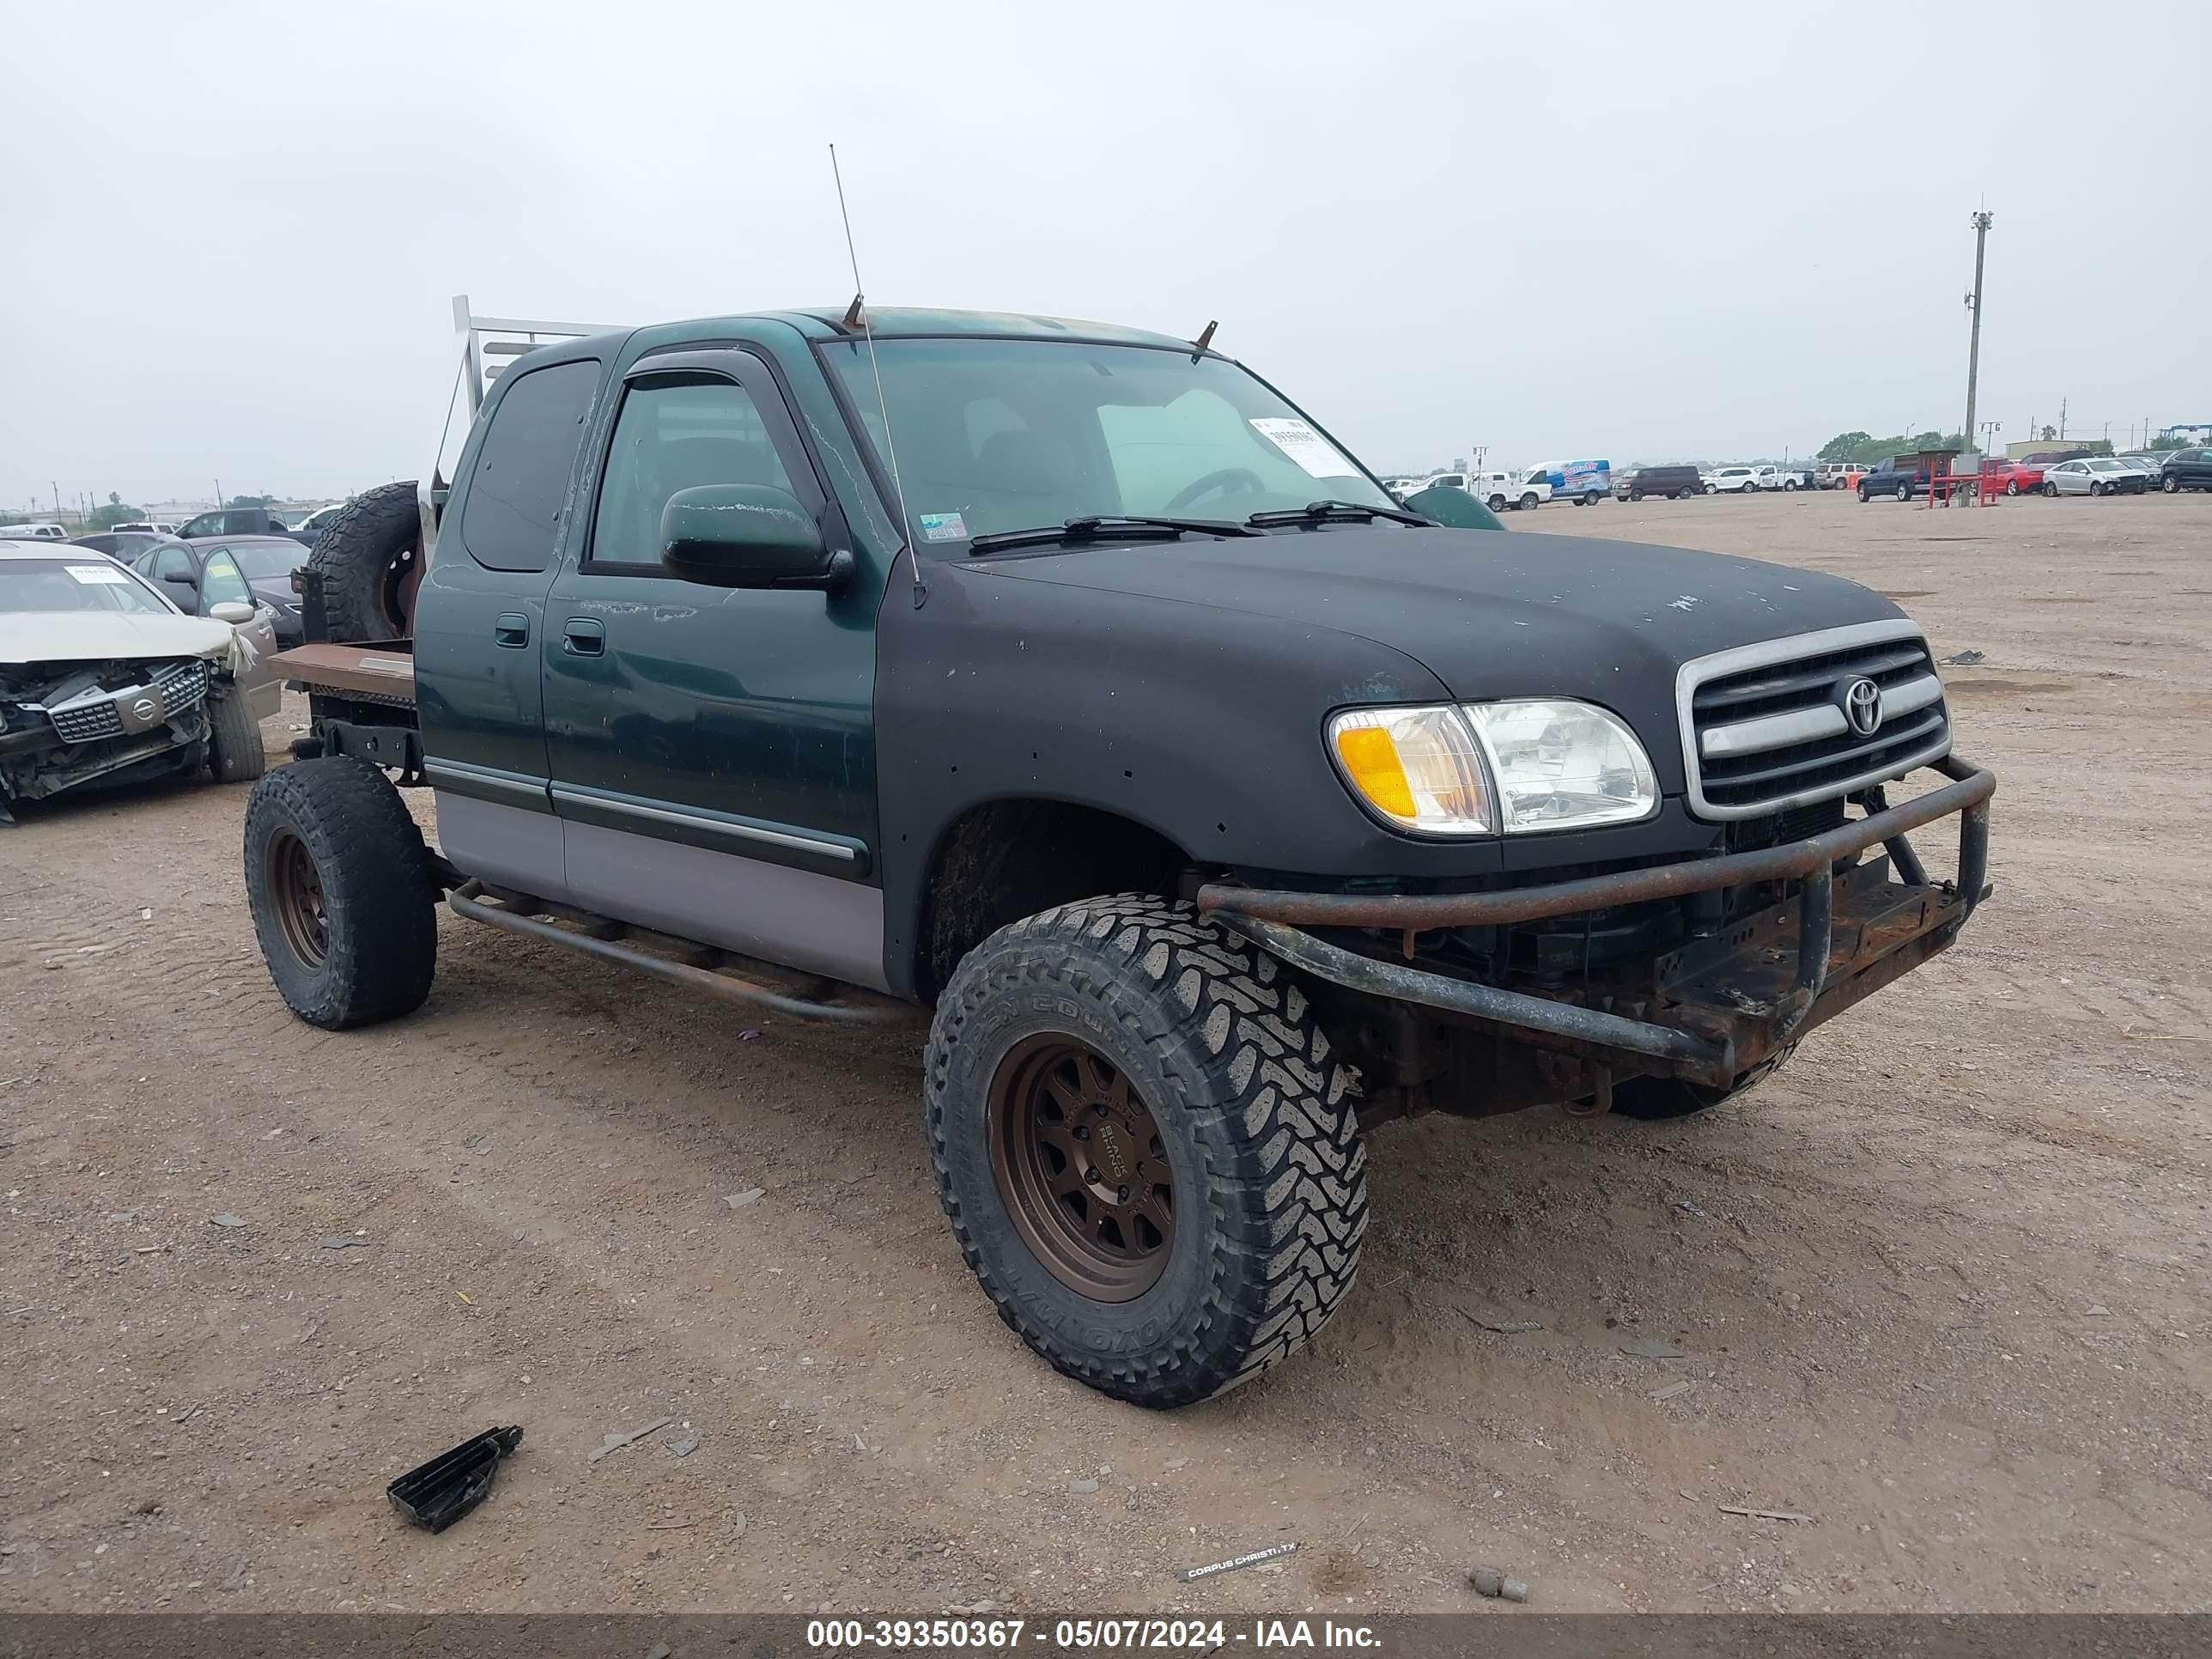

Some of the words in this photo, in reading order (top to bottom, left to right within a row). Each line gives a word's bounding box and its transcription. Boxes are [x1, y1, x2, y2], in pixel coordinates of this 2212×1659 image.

[1980, 423, 1985, 432] F
[1995, 422, 2001, 432] G
[1099, 1127, 1122, 1177] RHINO
[1104, 1125, 1127, 1175] BLACK
[1188, 1559, 1234, 1577] CORPUS
[1280, 1542, 1297, 1552] TX
